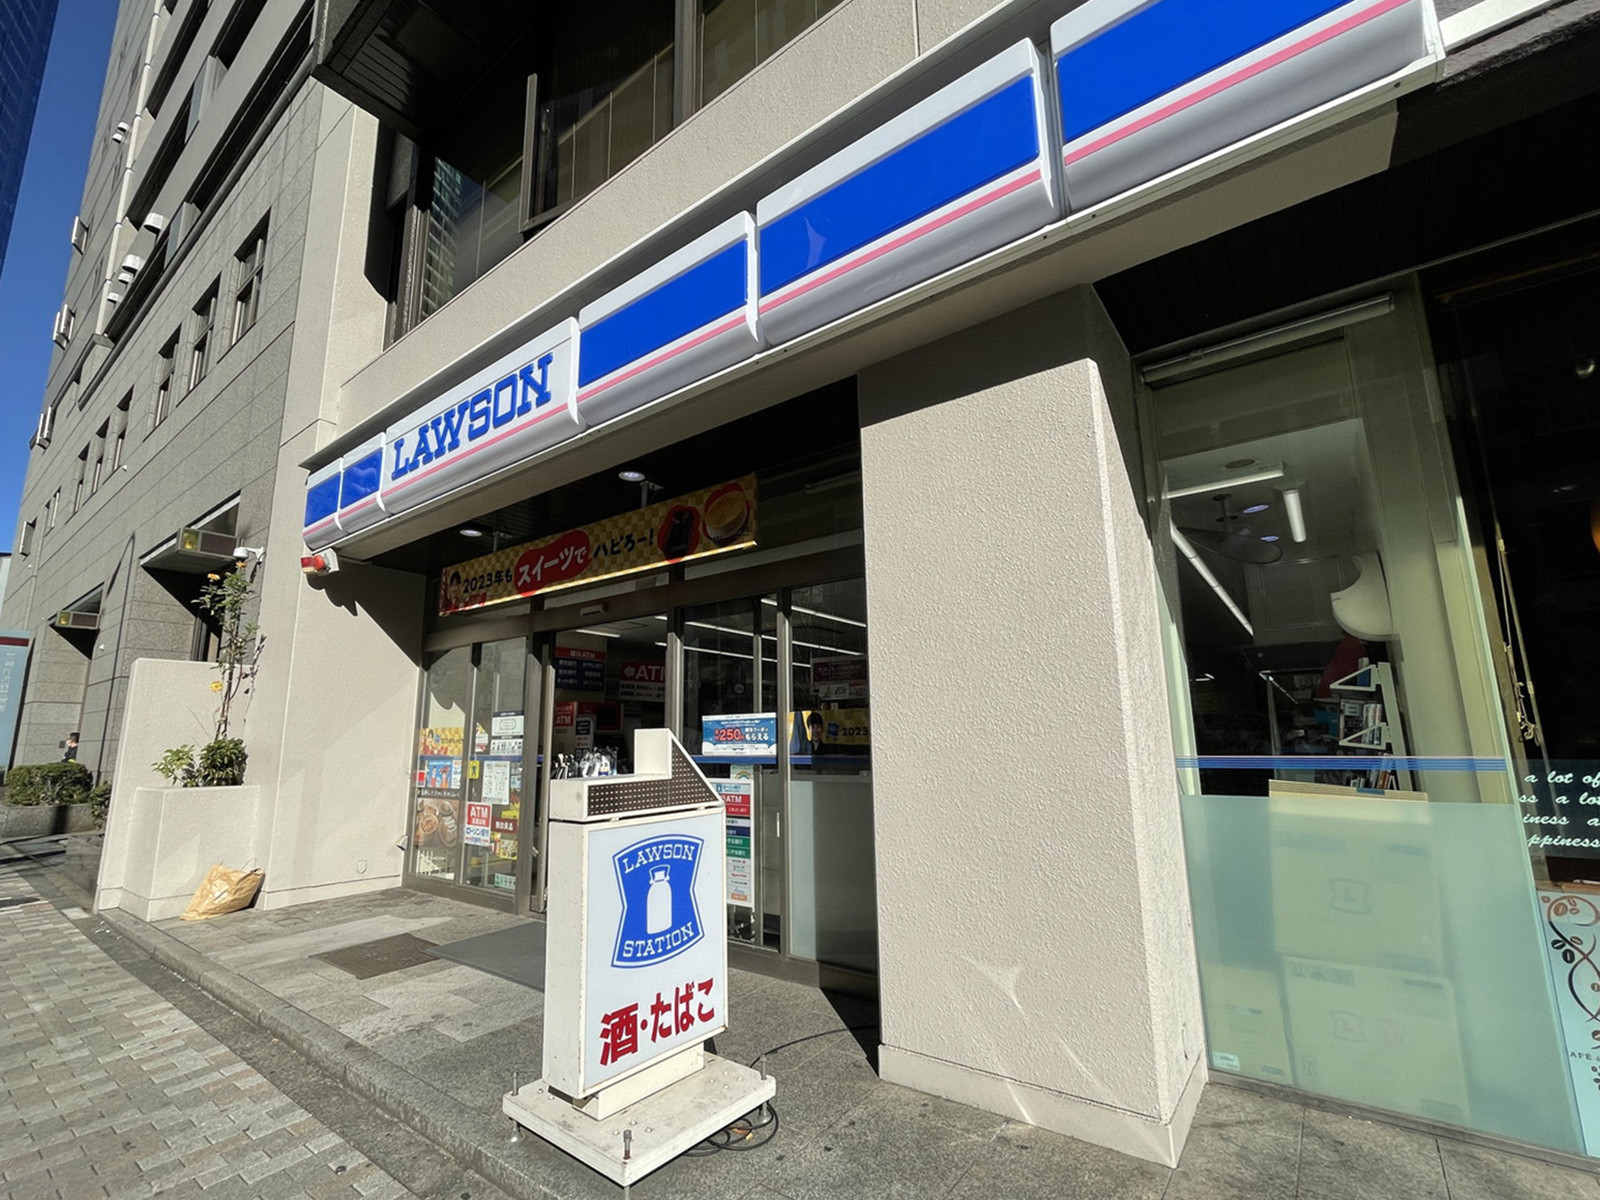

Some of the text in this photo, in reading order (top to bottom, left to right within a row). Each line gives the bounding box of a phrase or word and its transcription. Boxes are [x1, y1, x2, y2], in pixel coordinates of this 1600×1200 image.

[391, 352, 554, 481] LAWSON
[462, 570, 513, 594] 2023年も
[516, 545, 589, 587] スイーツで
[555, 715, 572, 725] ATM
[745, 732, 769, 741] もらえる
[841, 726, 868, 736] 2023
[1524, 774, 1538, 783] a
[1546, 770, 1573, 784] lot
[1555, 795, 1570, 805] a
[470, 806, 488, 819] ATM
[622, 843, 696, 875] LAWSON
[622, 921, 695, 958] STATION
[599, 977, 715, 1067] 酒・たばこ
